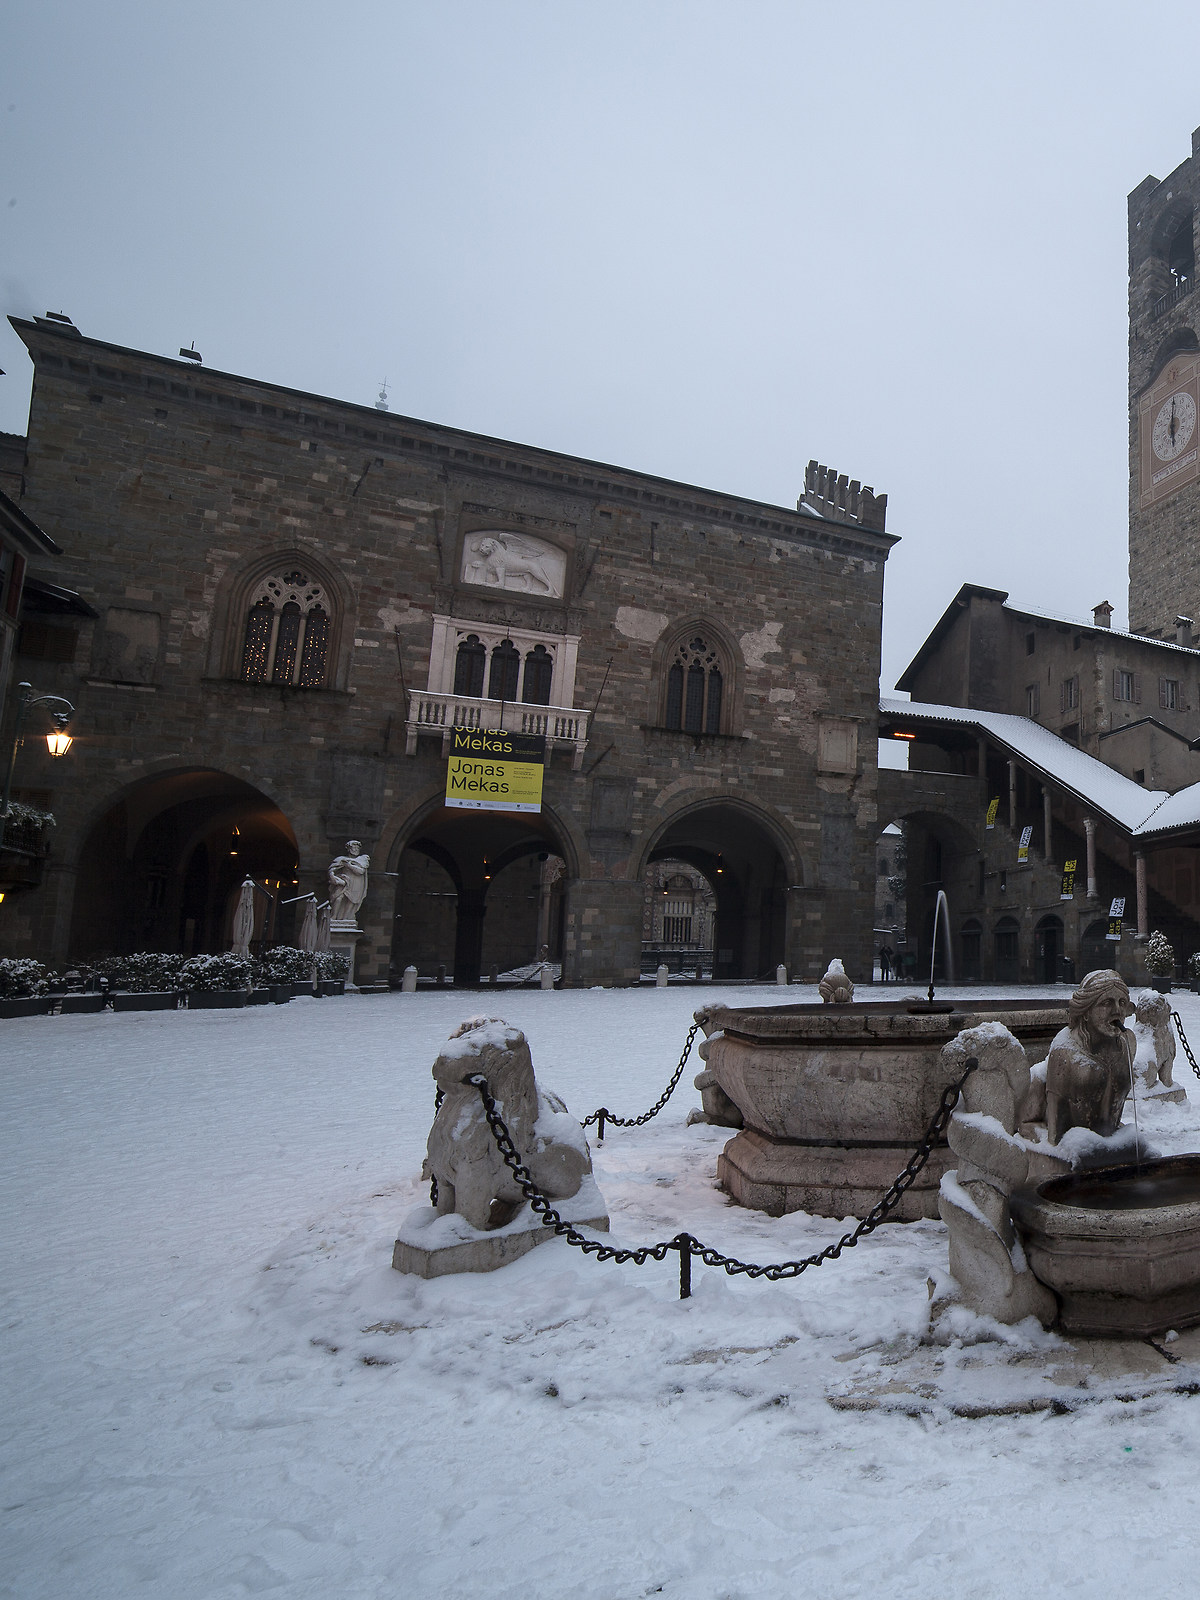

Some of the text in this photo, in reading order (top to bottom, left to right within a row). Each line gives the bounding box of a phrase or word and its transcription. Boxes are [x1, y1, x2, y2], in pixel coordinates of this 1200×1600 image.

[454, 734, 513, 753] Mekas
[451, 760, 505, 777] Jonas
[451, 776, 509, 794] Mekas
